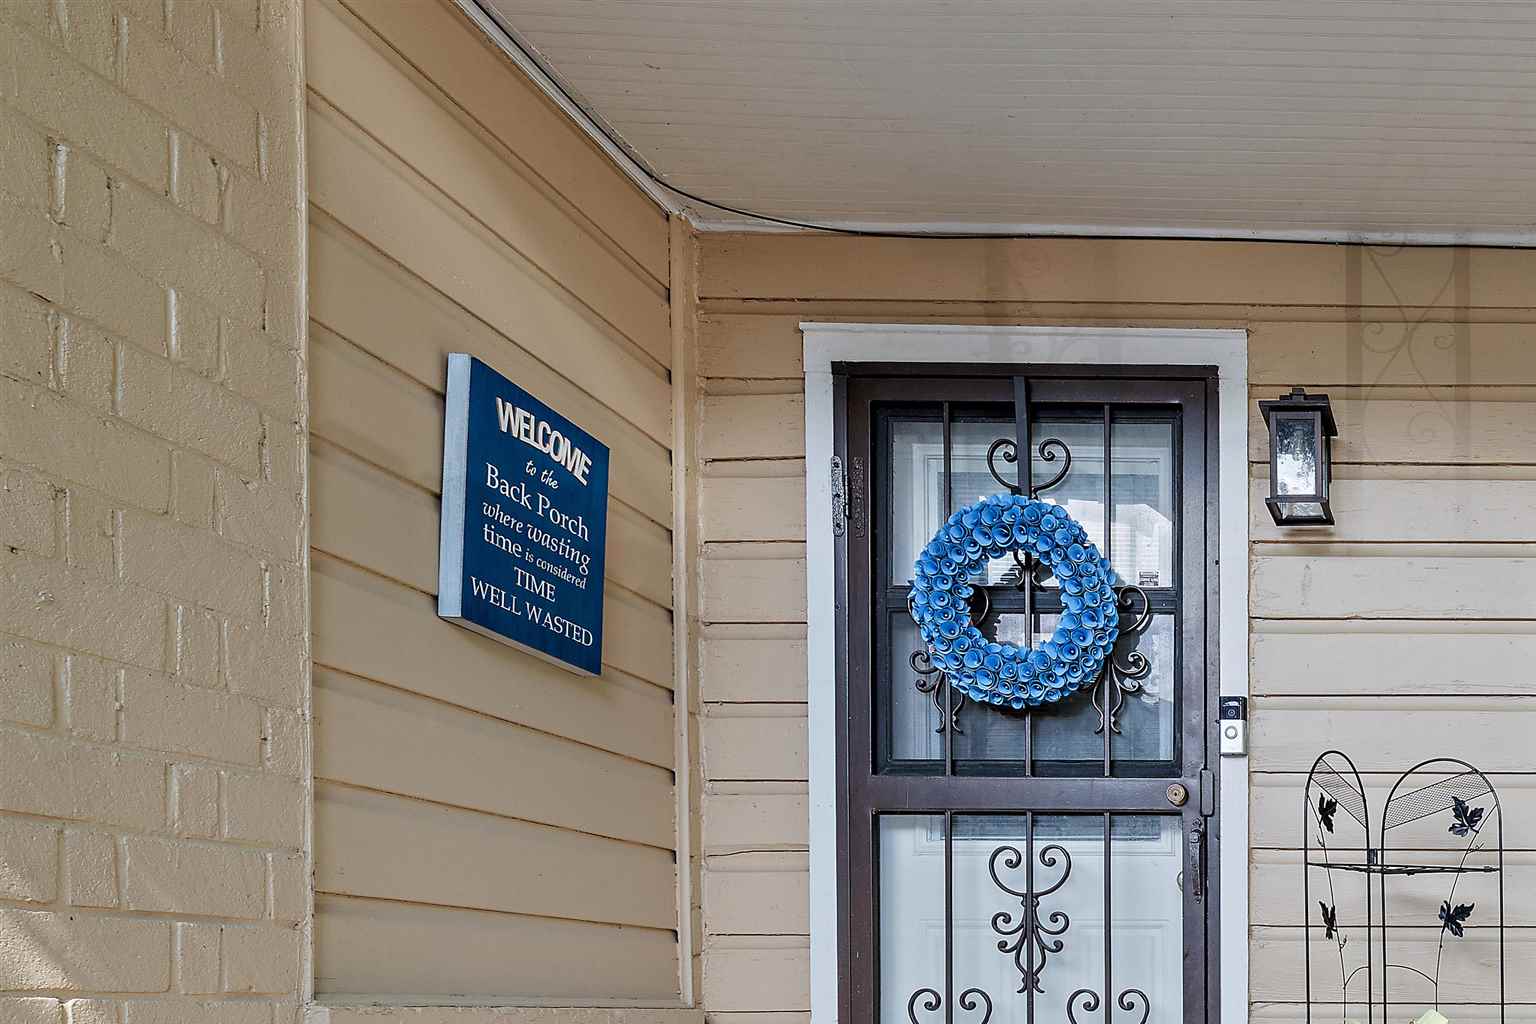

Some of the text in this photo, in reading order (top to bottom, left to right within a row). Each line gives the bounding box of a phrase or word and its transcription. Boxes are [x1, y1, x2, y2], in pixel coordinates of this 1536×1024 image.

[496, 397, 592, 486] WELCOME
[525, 459, 559, 490] to the
[483, 501, 591, 575] where wasting
[486, 463, 589, 542] Back Porch
[483, 523, 586, 589] time is considered
[514, 566, 556, 602] TIME
[471, 576, 593, 647] WELL WASTED
